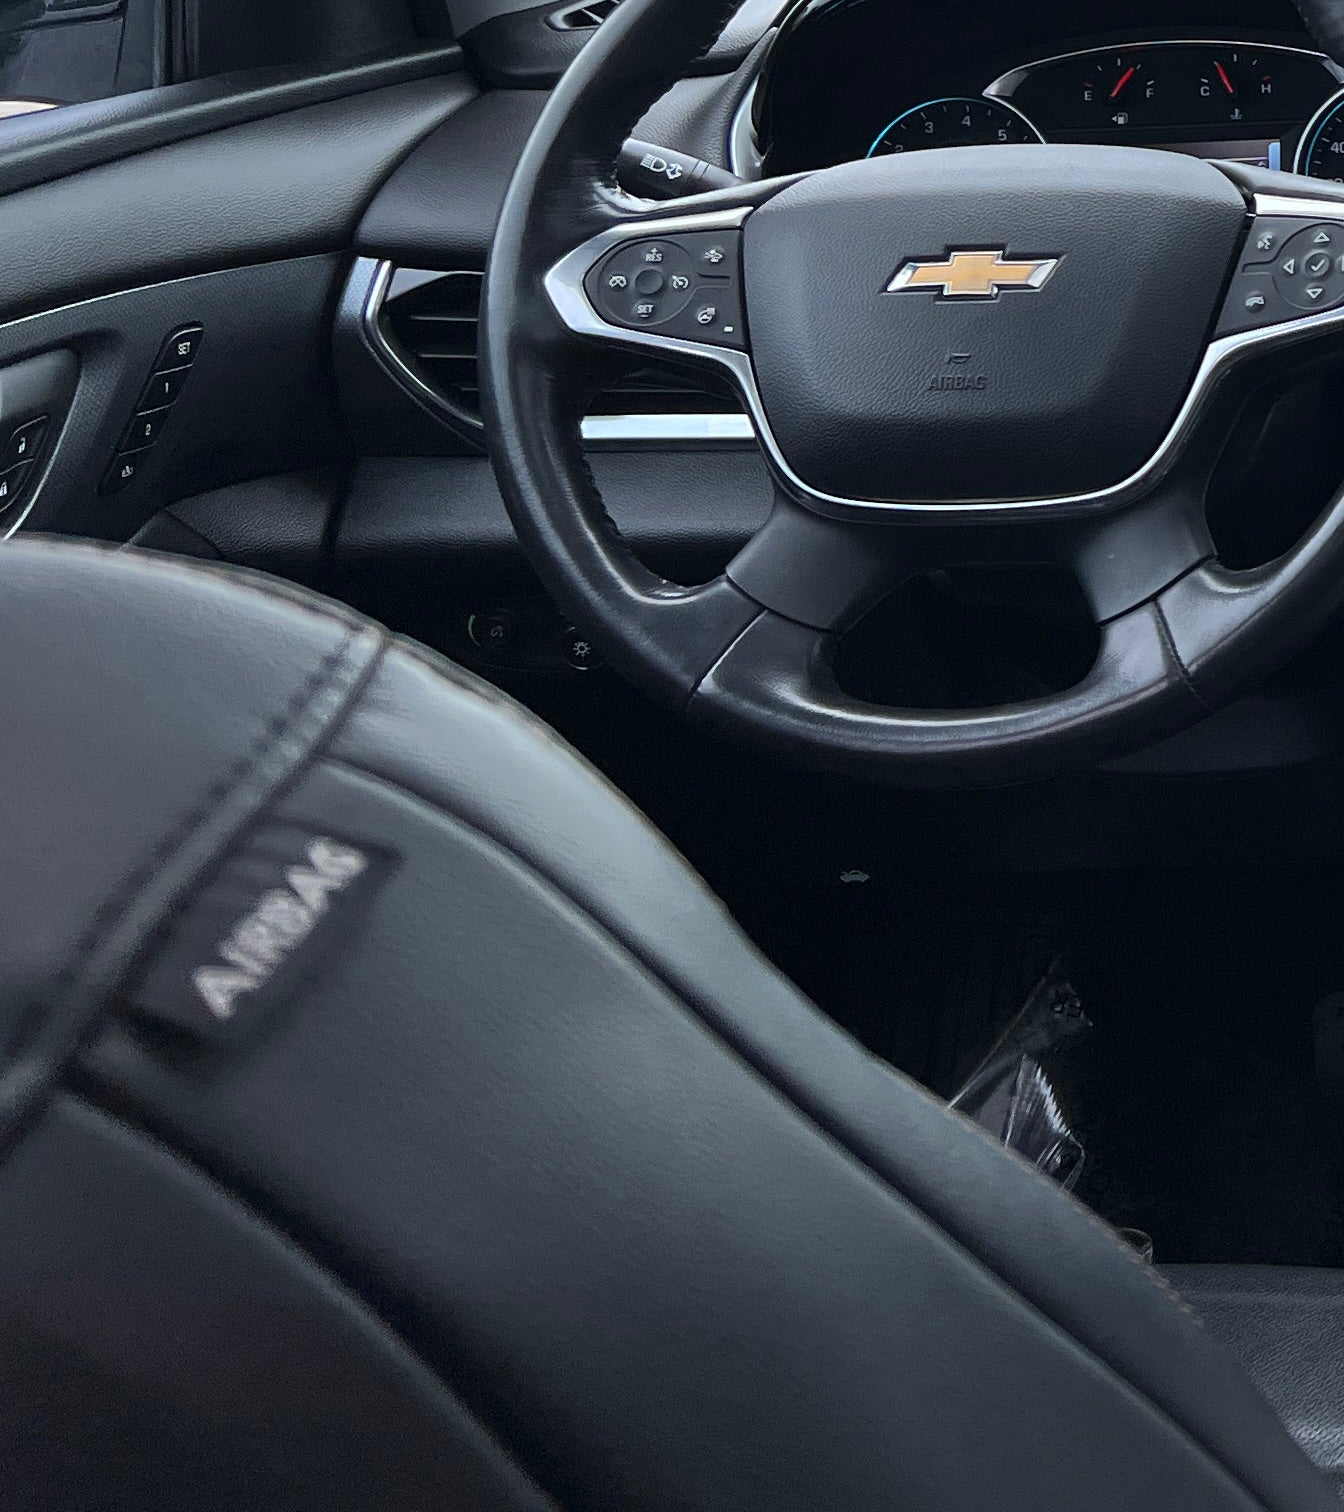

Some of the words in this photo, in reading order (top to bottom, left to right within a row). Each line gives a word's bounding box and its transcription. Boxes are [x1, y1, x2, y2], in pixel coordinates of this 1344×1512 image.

[1146, 88, 1155, 98] F
[1200, 86, 1210, 96] C
[1261, 84, 1271, 94] H
[1084, 91, 1093, 101] E
[961, 115, 971, 127] 4
[924, 121, 934, 133] 3
[998, 129, 1007, 141] 5
[645, 253, 662, 262] RES
[637, 304, 653, 314] SET
[178, 342, 190, 355] SET
[926, 375, 988, 391] AIRBAG
[145, 424, 151, 435] 2
[190, 837, 368, 1019] AIRBAG
